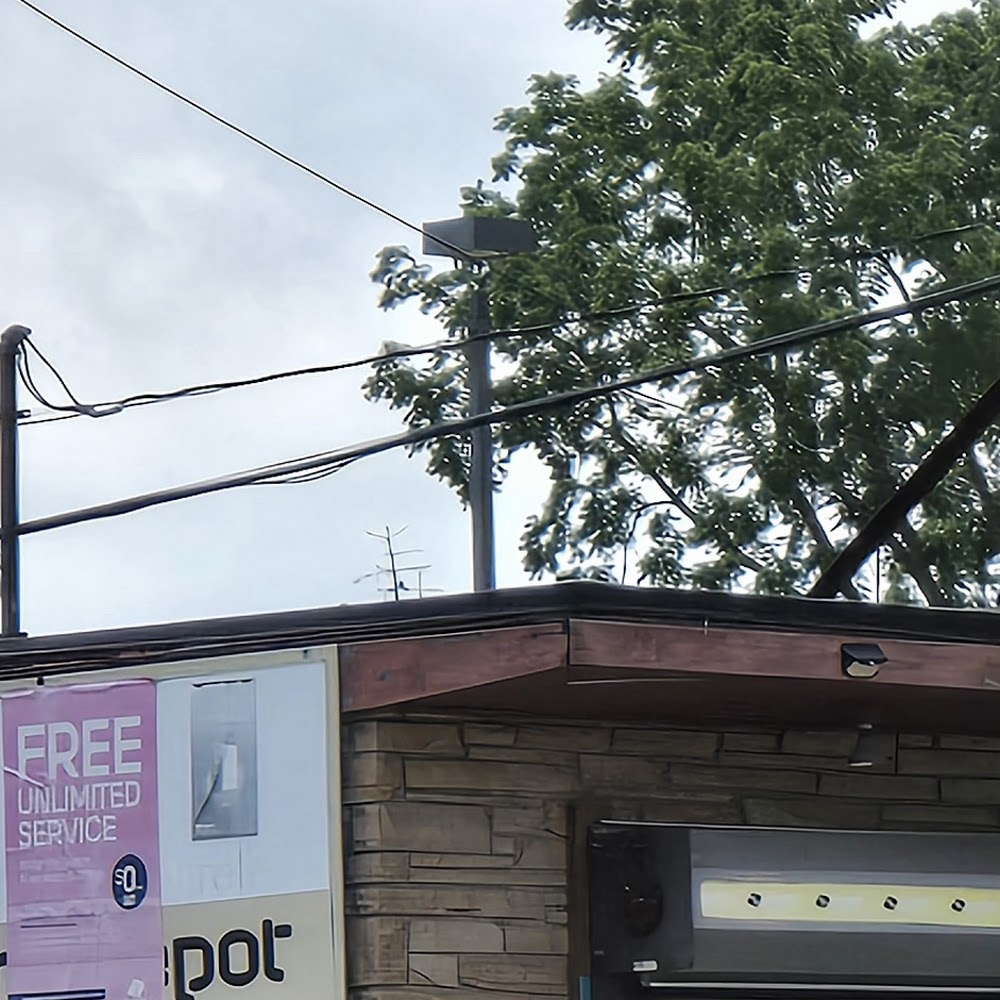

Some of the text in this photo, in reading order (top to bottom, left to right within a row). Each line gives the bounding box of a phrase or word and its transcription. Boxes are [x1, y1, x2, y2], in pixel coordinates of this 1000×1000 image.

[17, 715, 142, 778] FREE
[18, 780, 141, 815] UNLIMITED
[19, 815, 117, 849] SERVICE
